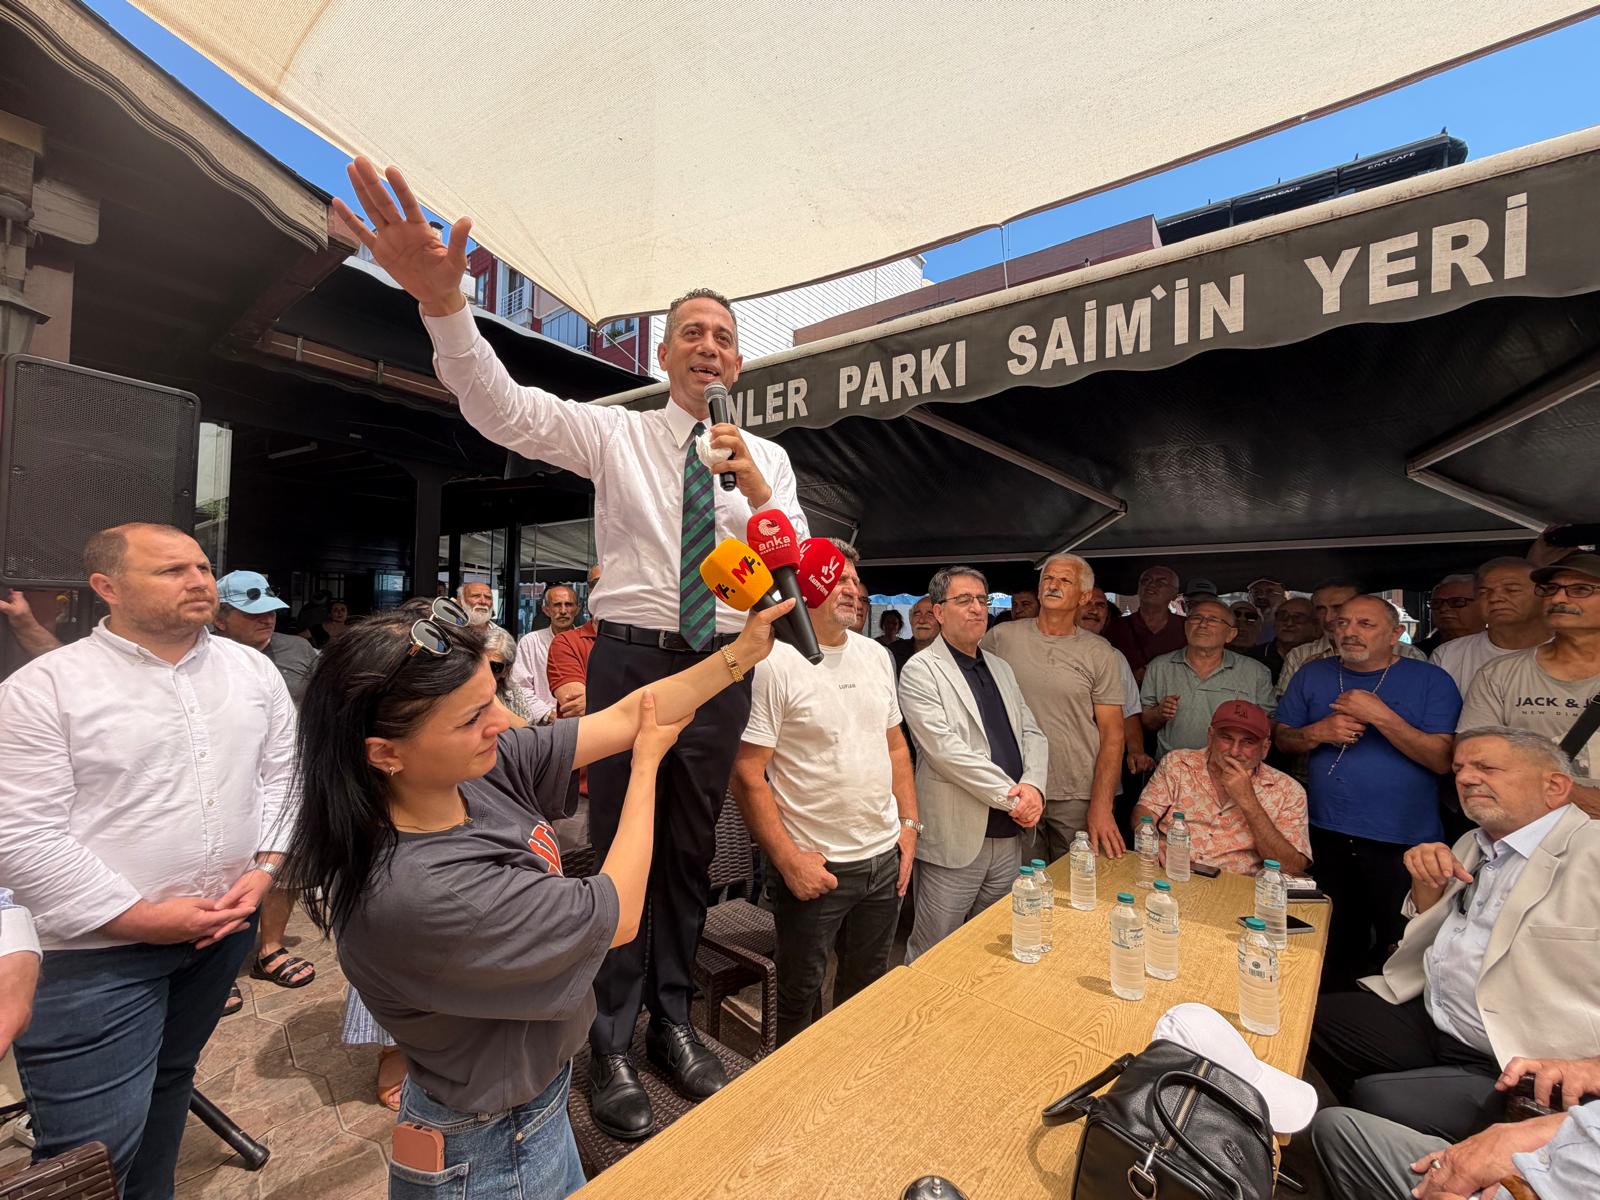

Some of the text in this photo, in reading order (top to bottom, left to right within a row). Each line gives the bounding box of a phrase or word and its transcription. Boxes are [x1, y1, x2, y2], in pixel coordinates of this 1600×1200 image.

[838, 339, 967, 409] PARKI
[1303, 192, 1528, 315] YERİ
[758, 535, 791, 551] anka
[1515, 697, 1559, 707] JACK
[1565, 698, 1580, 708] &
